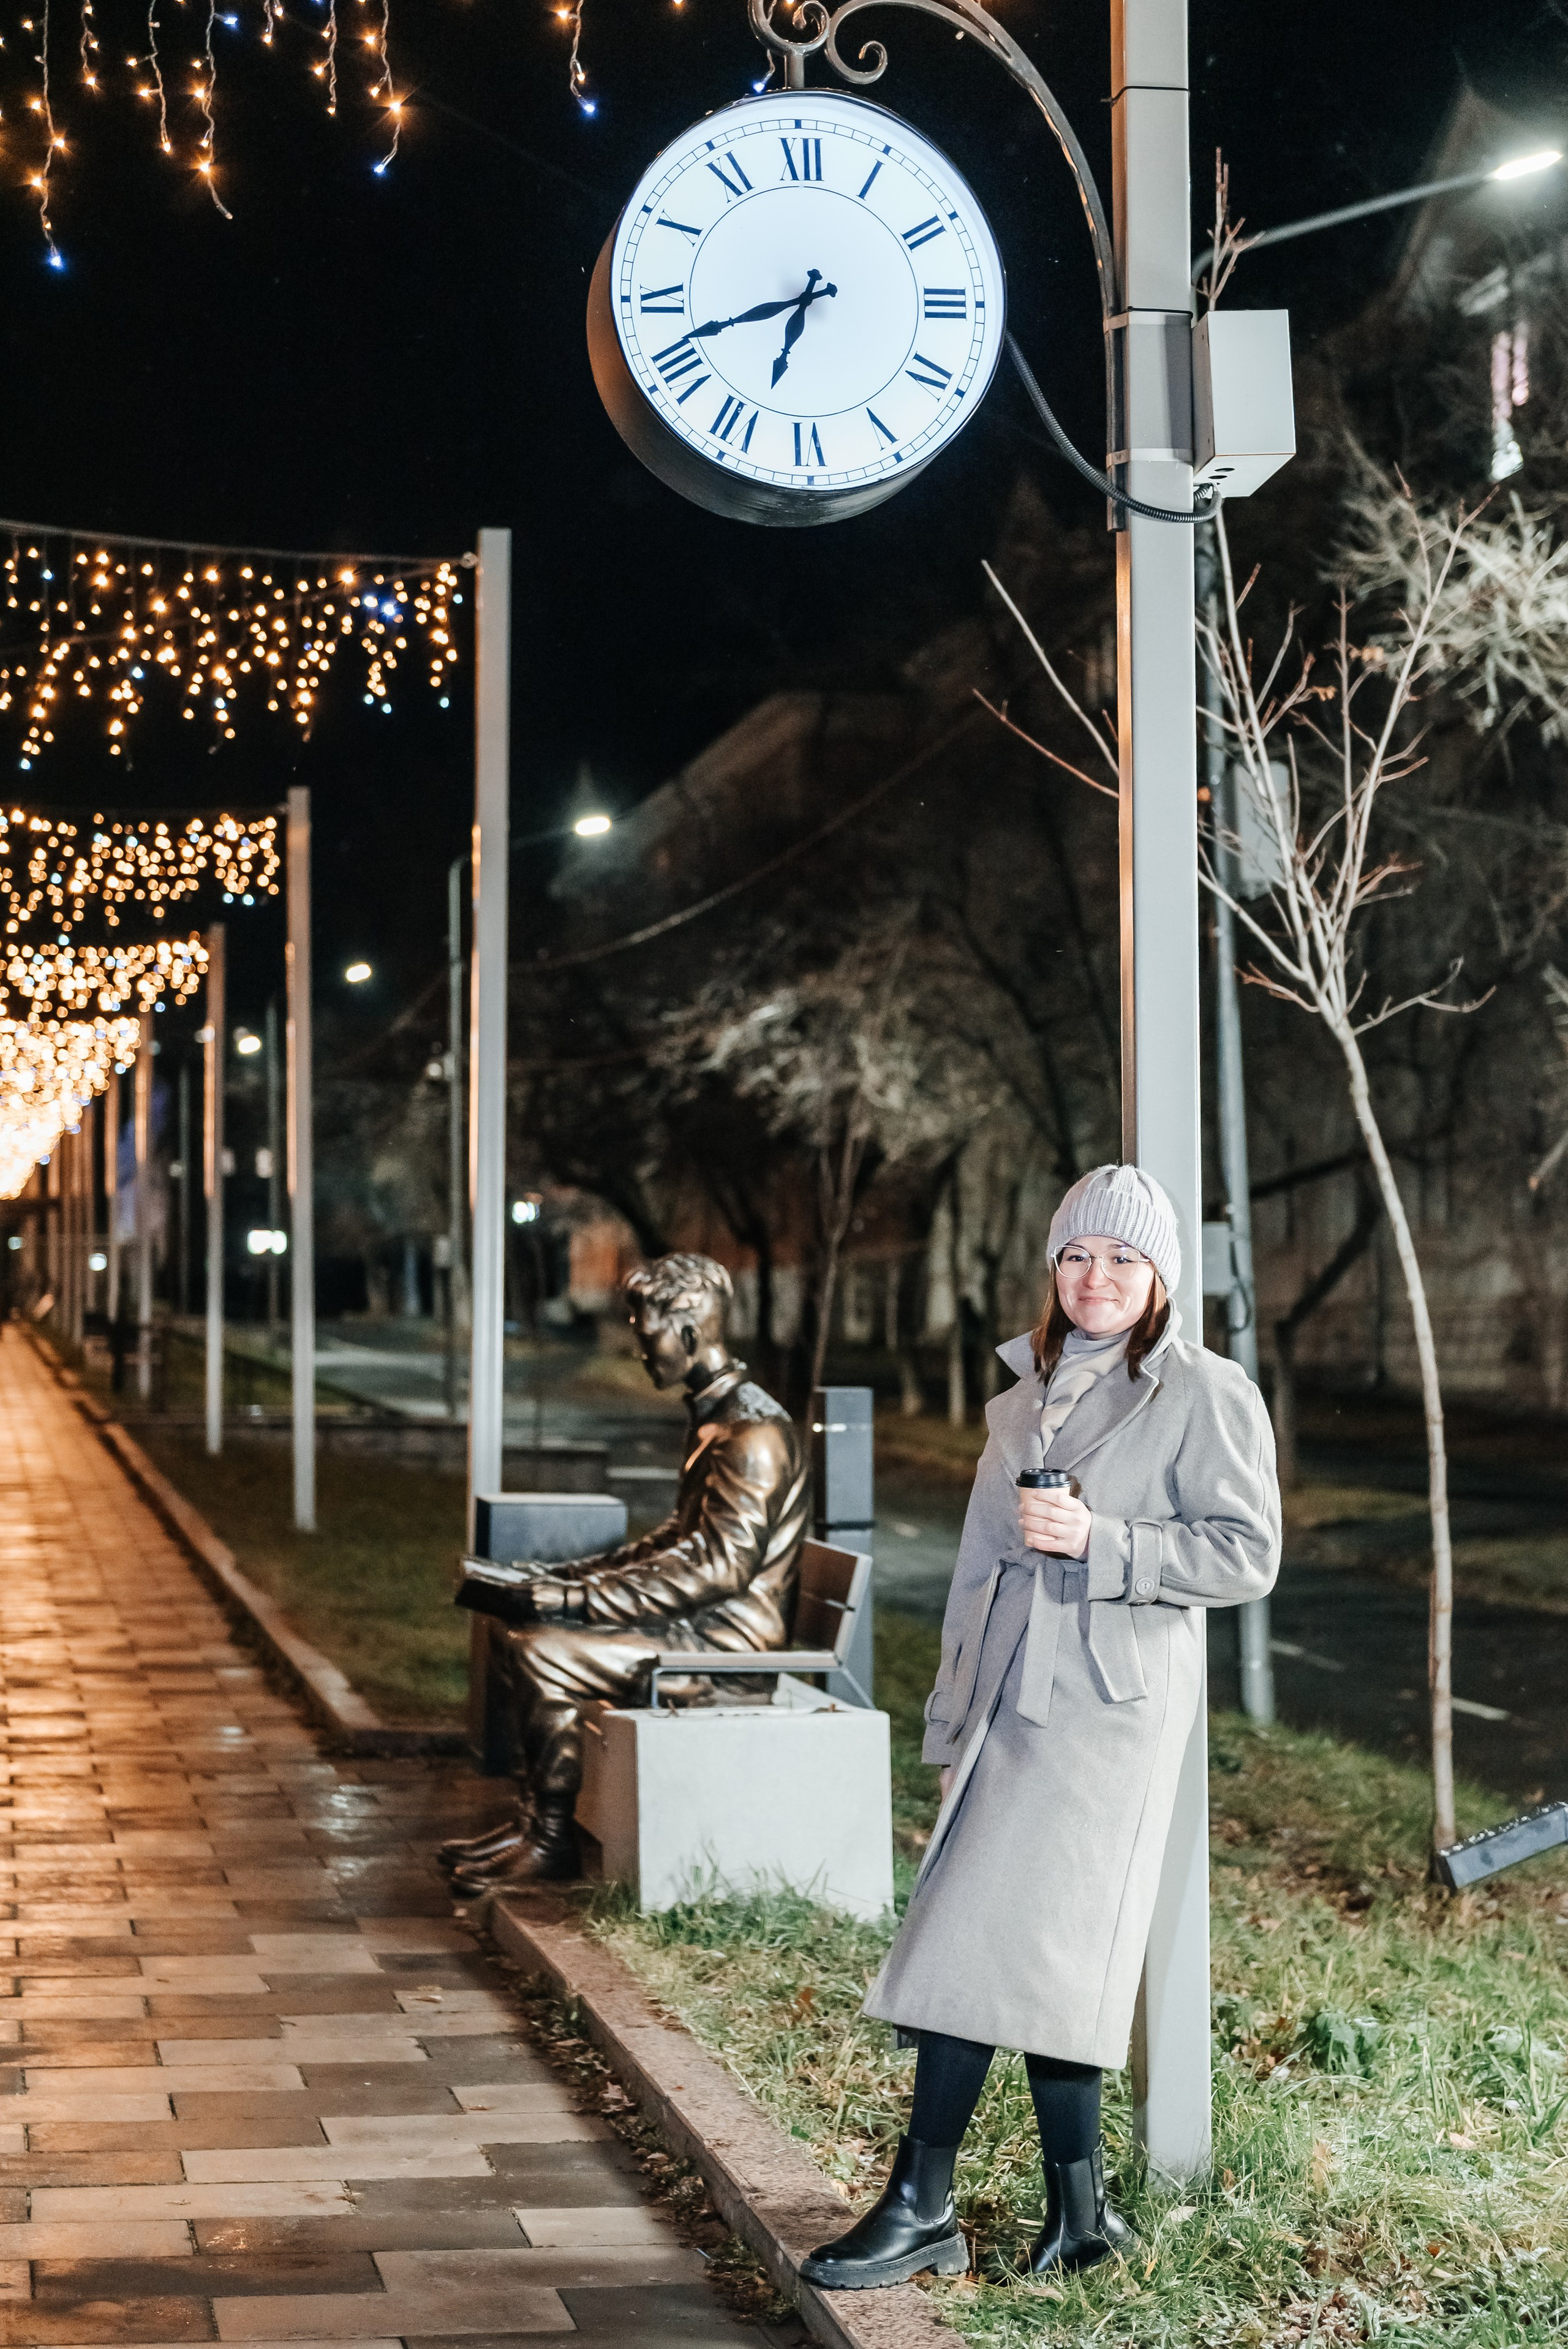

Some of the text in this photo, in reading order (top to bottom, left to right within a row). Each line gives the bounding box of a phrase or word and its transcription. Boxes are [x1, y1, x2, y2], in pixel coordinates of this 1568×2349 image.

[704, 150, 755, 203] XI
[778, 138, 824, 180] XII
[856, 159, 885, 200] I
[655, 209, 703, 247] X
[900, 213, 948, 252] II
[640, 282, 685, 315] IX
[924, 286, 967, 320] III
[649, 336, 711, 407] VIII
[905, 351, 954, 402] IV
[707, 393, 759, 454] VII
[791, 422, 827, 466] VI
[867, 407, 899, 451] V
